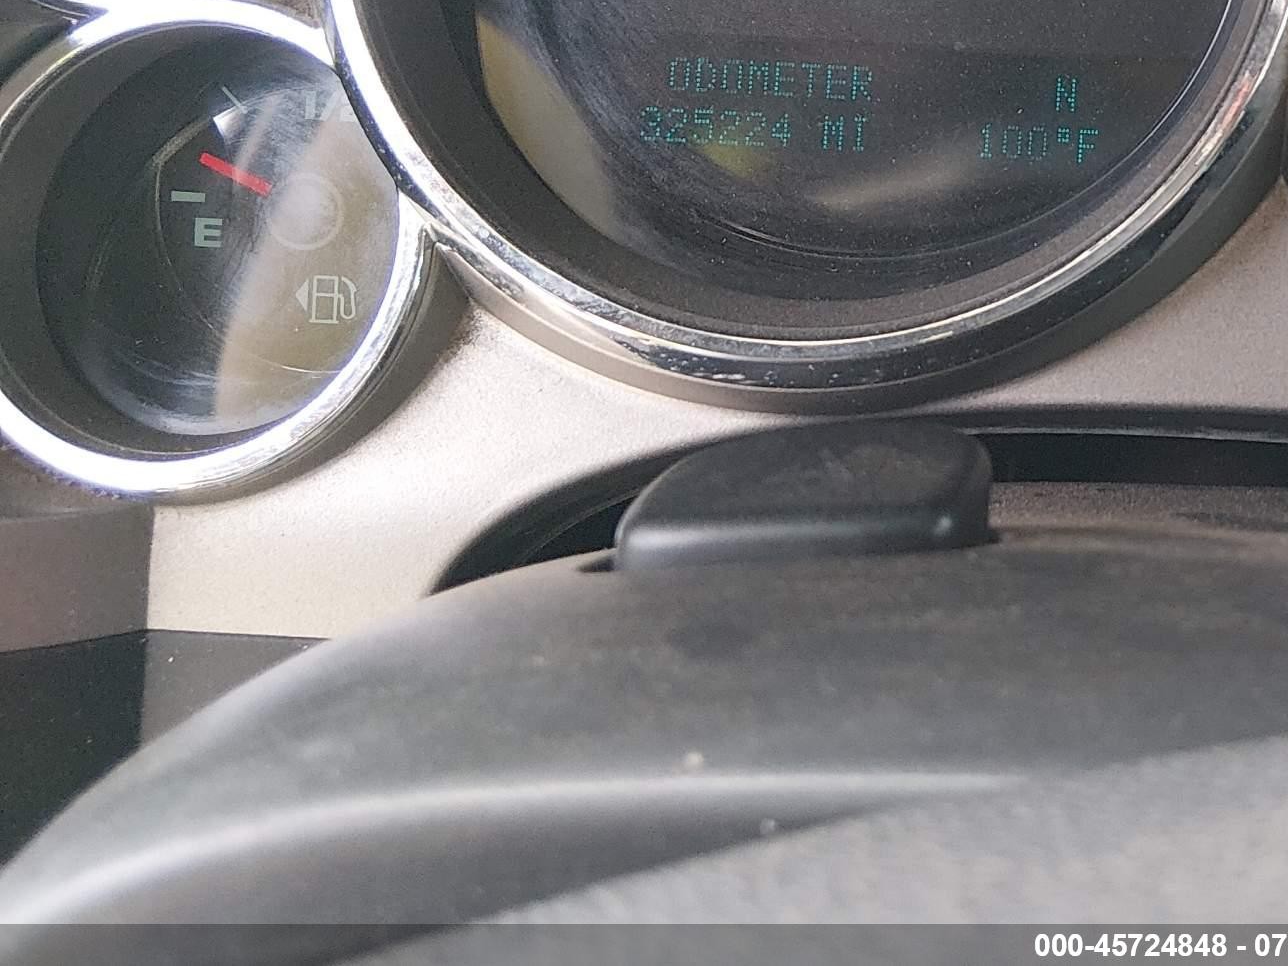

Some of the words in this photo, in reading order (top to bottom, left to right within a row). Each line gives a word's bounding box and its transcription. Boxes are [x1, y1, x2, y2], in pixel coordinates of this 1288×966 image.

[669, 57, 873, 101] ODOMETER
[1055, 76, 1077, 112] N
[823, 113, 868, 152] MI
[194, 217, 223, 248] E
